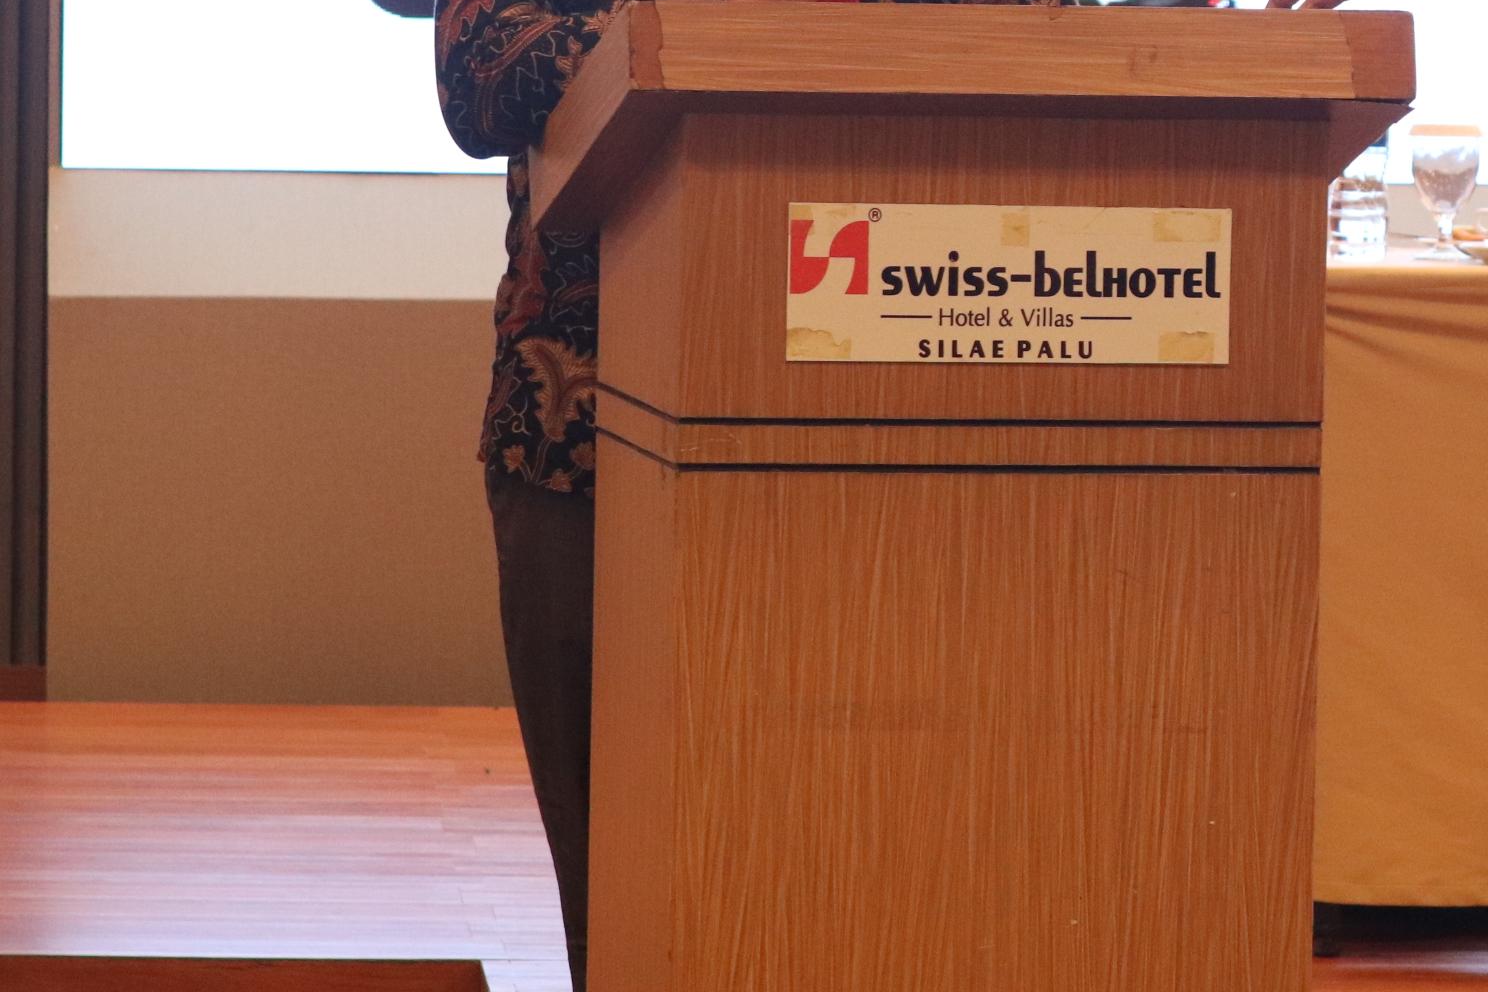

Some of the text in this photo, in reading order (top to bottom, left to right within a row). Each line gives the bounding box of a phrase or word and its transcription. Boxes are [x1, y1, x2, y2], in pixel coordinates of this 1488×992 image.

[938, 307, 1075, 328] Hotel & Villas
[918, 339, 1094, 360] SILAE PALU
